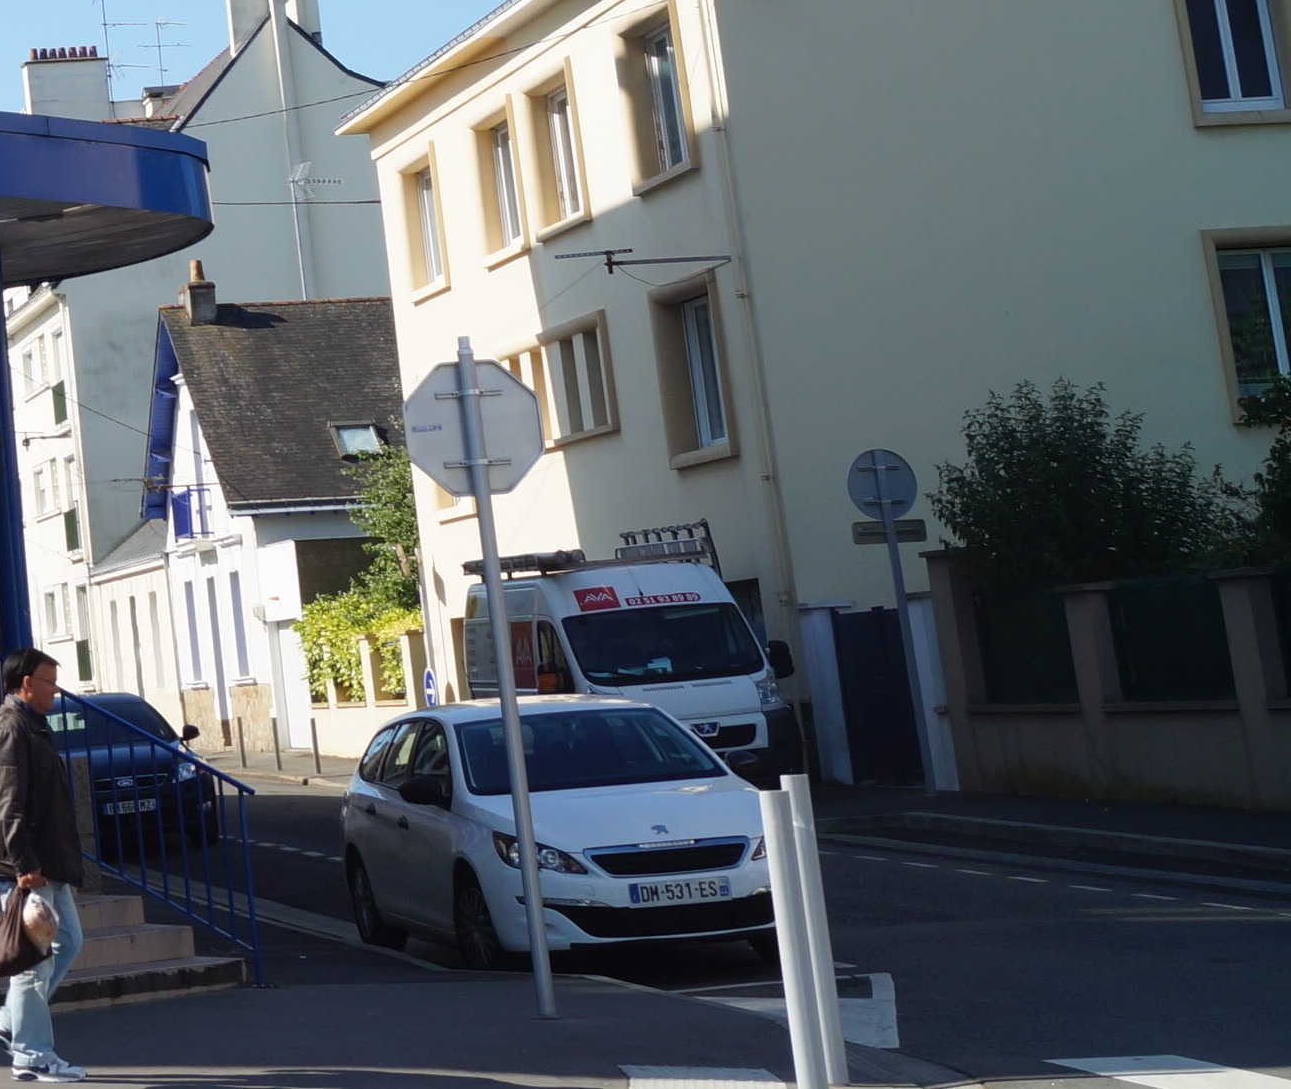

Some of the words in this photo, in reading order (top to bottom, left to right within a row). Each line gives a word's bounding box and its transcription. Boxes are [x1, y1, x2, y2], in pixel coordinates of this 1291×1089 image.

[584, 592, 613, 604] AVA
[628, 597, 641, 606] 02
[645, 596, 656, 604] 51
[658, 595, 670, 603] 93
[672, 594, 684, 602] 89
[686, 593, 698, 601] 89
[640, 881, 717, 903] DM-531-ES
